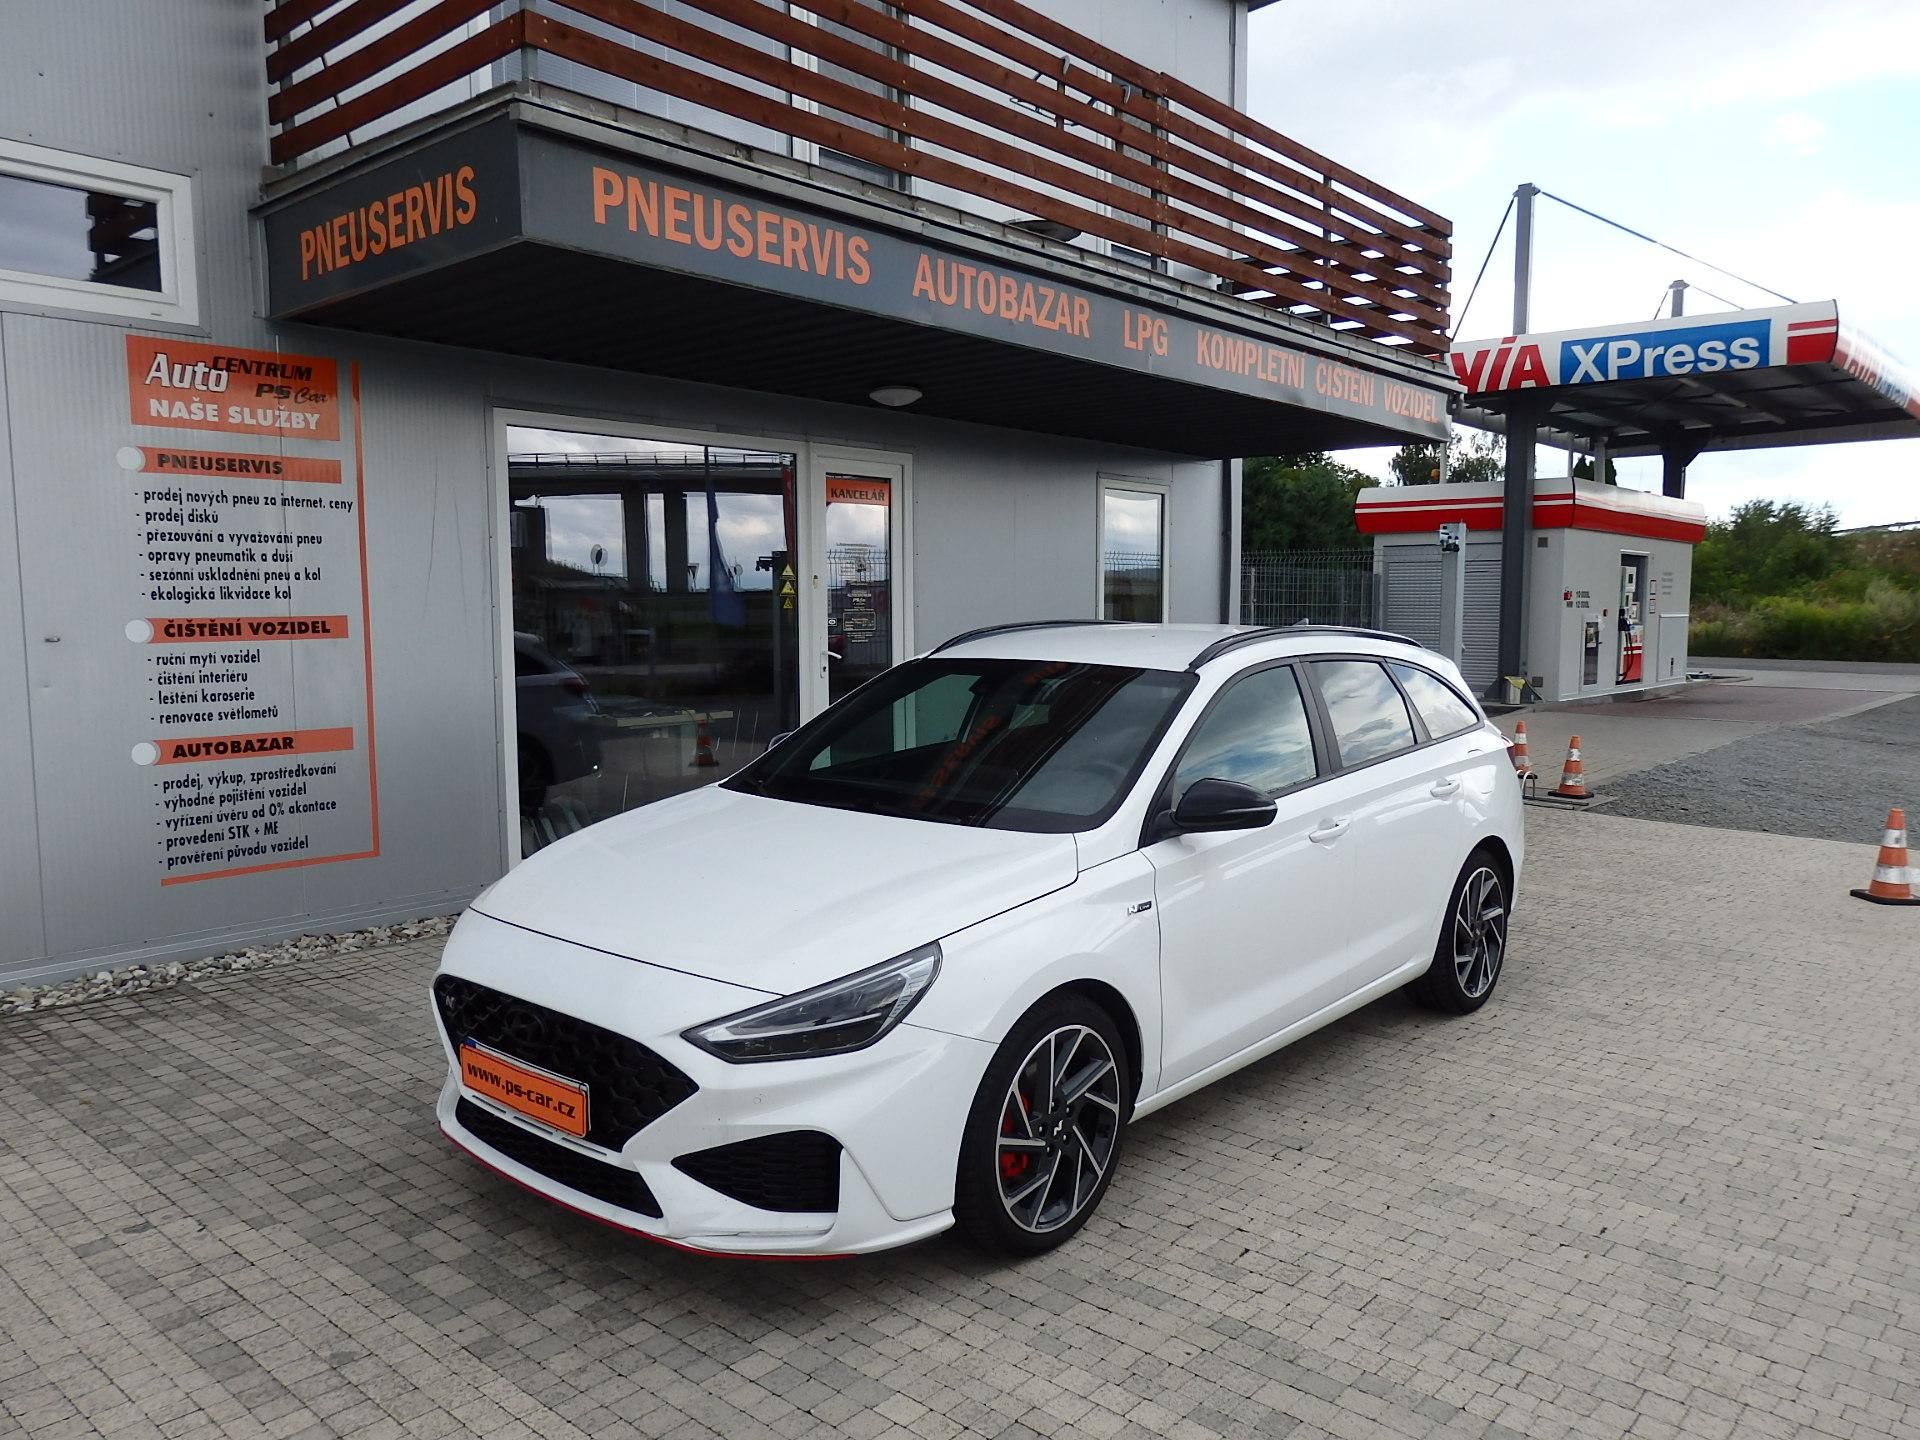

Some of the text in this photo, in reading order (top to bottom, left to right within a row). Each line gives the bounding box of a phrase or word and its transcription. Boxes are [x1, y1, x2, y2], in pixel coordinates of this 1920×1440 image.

[300, 165, 477, 281] PNEUSERVIS
[593, 166, 871, 286] PNEUSERVIS
[912, 253, 1091, 339] AUTOBAZAR
[1123, 309, 1169, 357] LPG
[1384, 382, 1439, 424] VOZIDEL
[144, 352, 314, 393] Auto CENTRUM
[1450, 336, 1760, 391] VIA XPress
[256, 383, 292, 399] PS
[149, 396, 321, 430] NAŠE SLUŽBY
[157, 453, 284, 475] PNEUSERVIS
[144, 487, 353, 513] prodej nových pneu za internet. ceny
[831, 487, 886, 502] KANCELÁŘ
[145, 507, 219, 526] prodej disků
[146, 528, 322, 548] přezouvání a vyvažování pneu
[148, 551, 191, 566] opravy
[195, 548, 256, 566] pneumatik
[261, 552, 268, 562] a
[149, 566, 321, 584] sezónní uskladnění pneu a kol
[150, 585, 292, 604] ekologická likvidace kol
[163, 618, 331, 638] ČIŠTĚNÍ VOZIDEL
[156, 652, 186, 666] ruční
[220, 648, 261, 664] vozidel
[157, 668, 248, 686] čištění interiéru
[158, 686, 255, 705] leštění karoserie
[159, 704, 279, 724] renovace světlometů
[172, 736, 295, 759] AUTOBAZAR
[163, 773, 204, 794] prodej,
[250, 762, 337, 785] zprostředkování
[164, 781, 307, 812] výhodné pojištění vozidel
[251, 804, 266, 819] od
[269, 801, 285, 817] 0%
[288, 799, 337, 815] akontace
[166, 828, 225, 852] provedení
[228, 823, 251, 840] STK
[263, 820, 279, 836] ME
[227, 840, 268, 862] původu
[271, 834, 309, 853] vozidel
[467, 1062, 576, 1119] www.ps-car.cz
